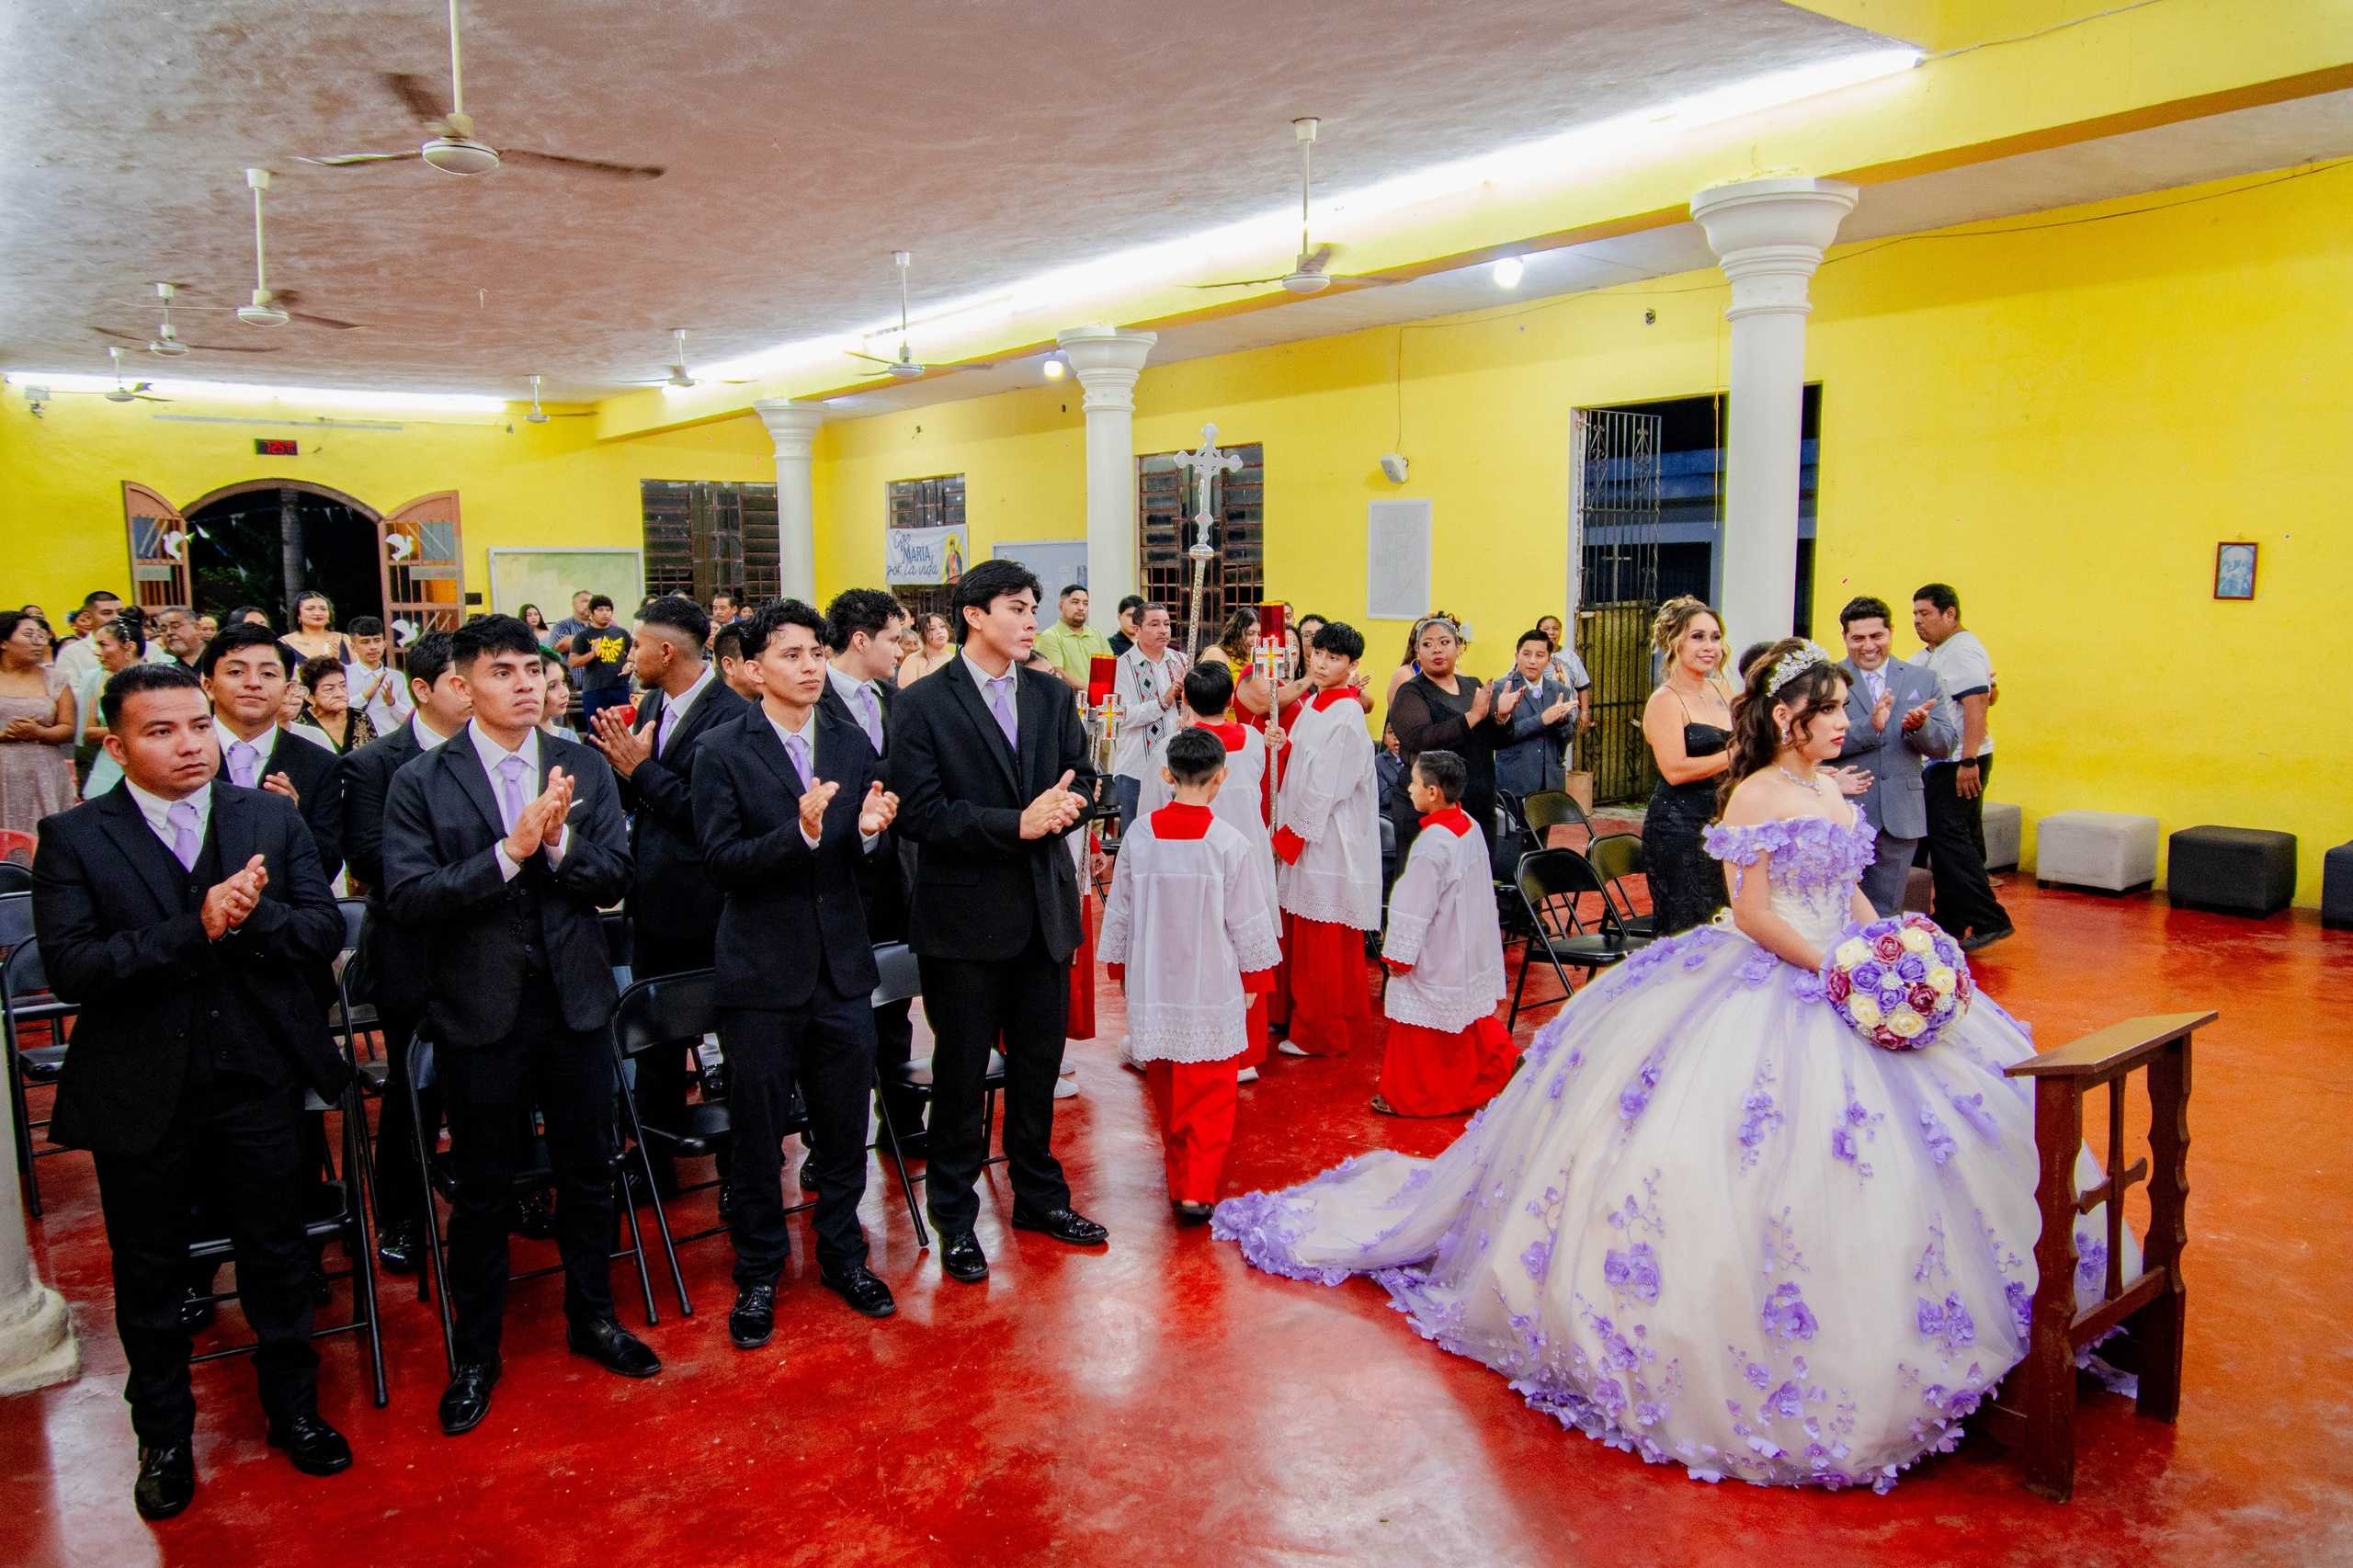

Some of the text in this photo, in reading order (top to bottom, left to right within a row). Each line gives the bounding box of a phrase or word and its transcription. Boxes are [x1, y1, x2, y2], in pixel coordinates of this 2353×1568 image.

[893, 529, 911, 549] Con
[901, 542, 931, 564] MARÍA
[887, 555, 938, 578] por la vida
